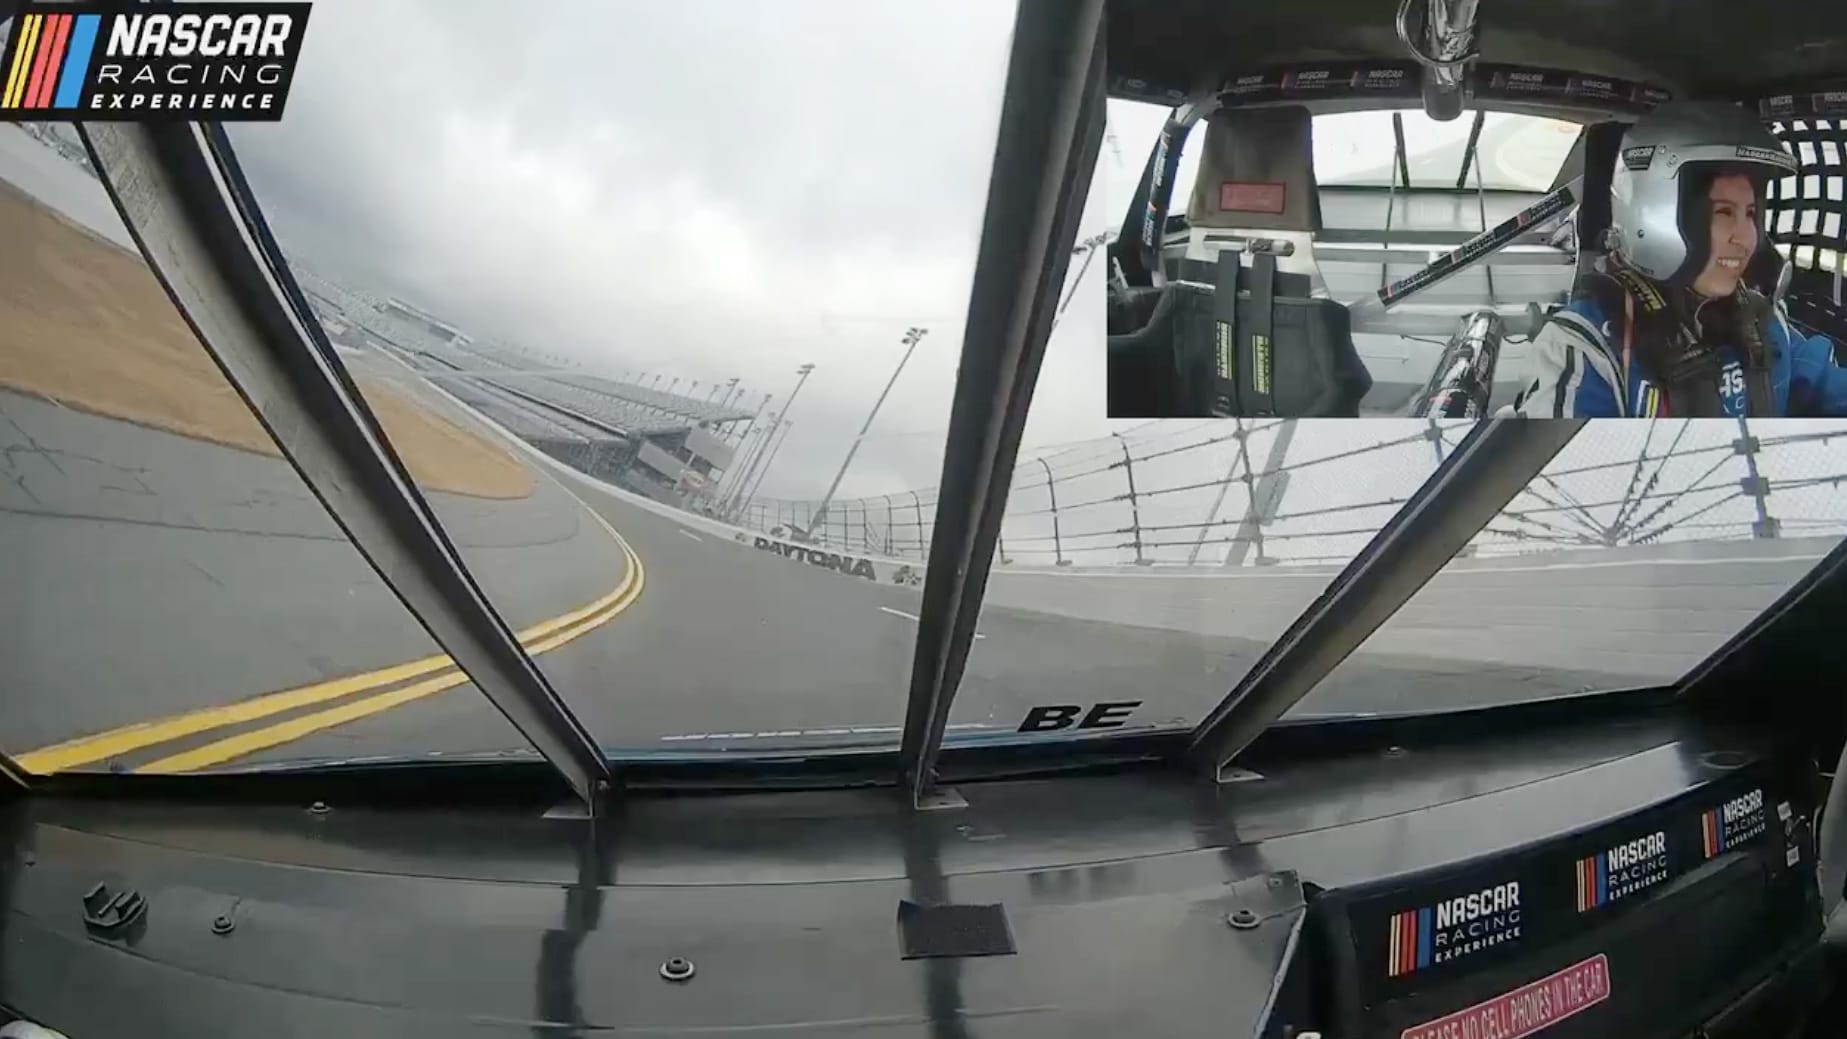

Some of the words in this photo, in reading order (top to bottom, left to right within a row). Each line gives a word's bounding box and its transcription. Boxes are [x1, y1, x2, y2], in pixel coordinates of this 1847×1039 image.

[753, 536, 877, 581] DAYTONA
[1017, 701, 1144, 733] BE
[1723, 788, 1763, 824] NASCAR
[1608, 831, 1666, 873] NASCAR
[1609, 855, 1667, 889] RACING
[1436, 881, 1520, 930] NASCAR
[1435, 909, 1520, 947] RACING
[1435, 926, 1521, 963] EXPERIENCE
[1480, 1001, 1511, 1039] CELL
[1510, 985, 1552, 1032] PHONES
[1552, 979, 1564, 1016] IN
[1564, 971, 1584, 1009] THE
[1583, 962, 1604, 999] CAR
